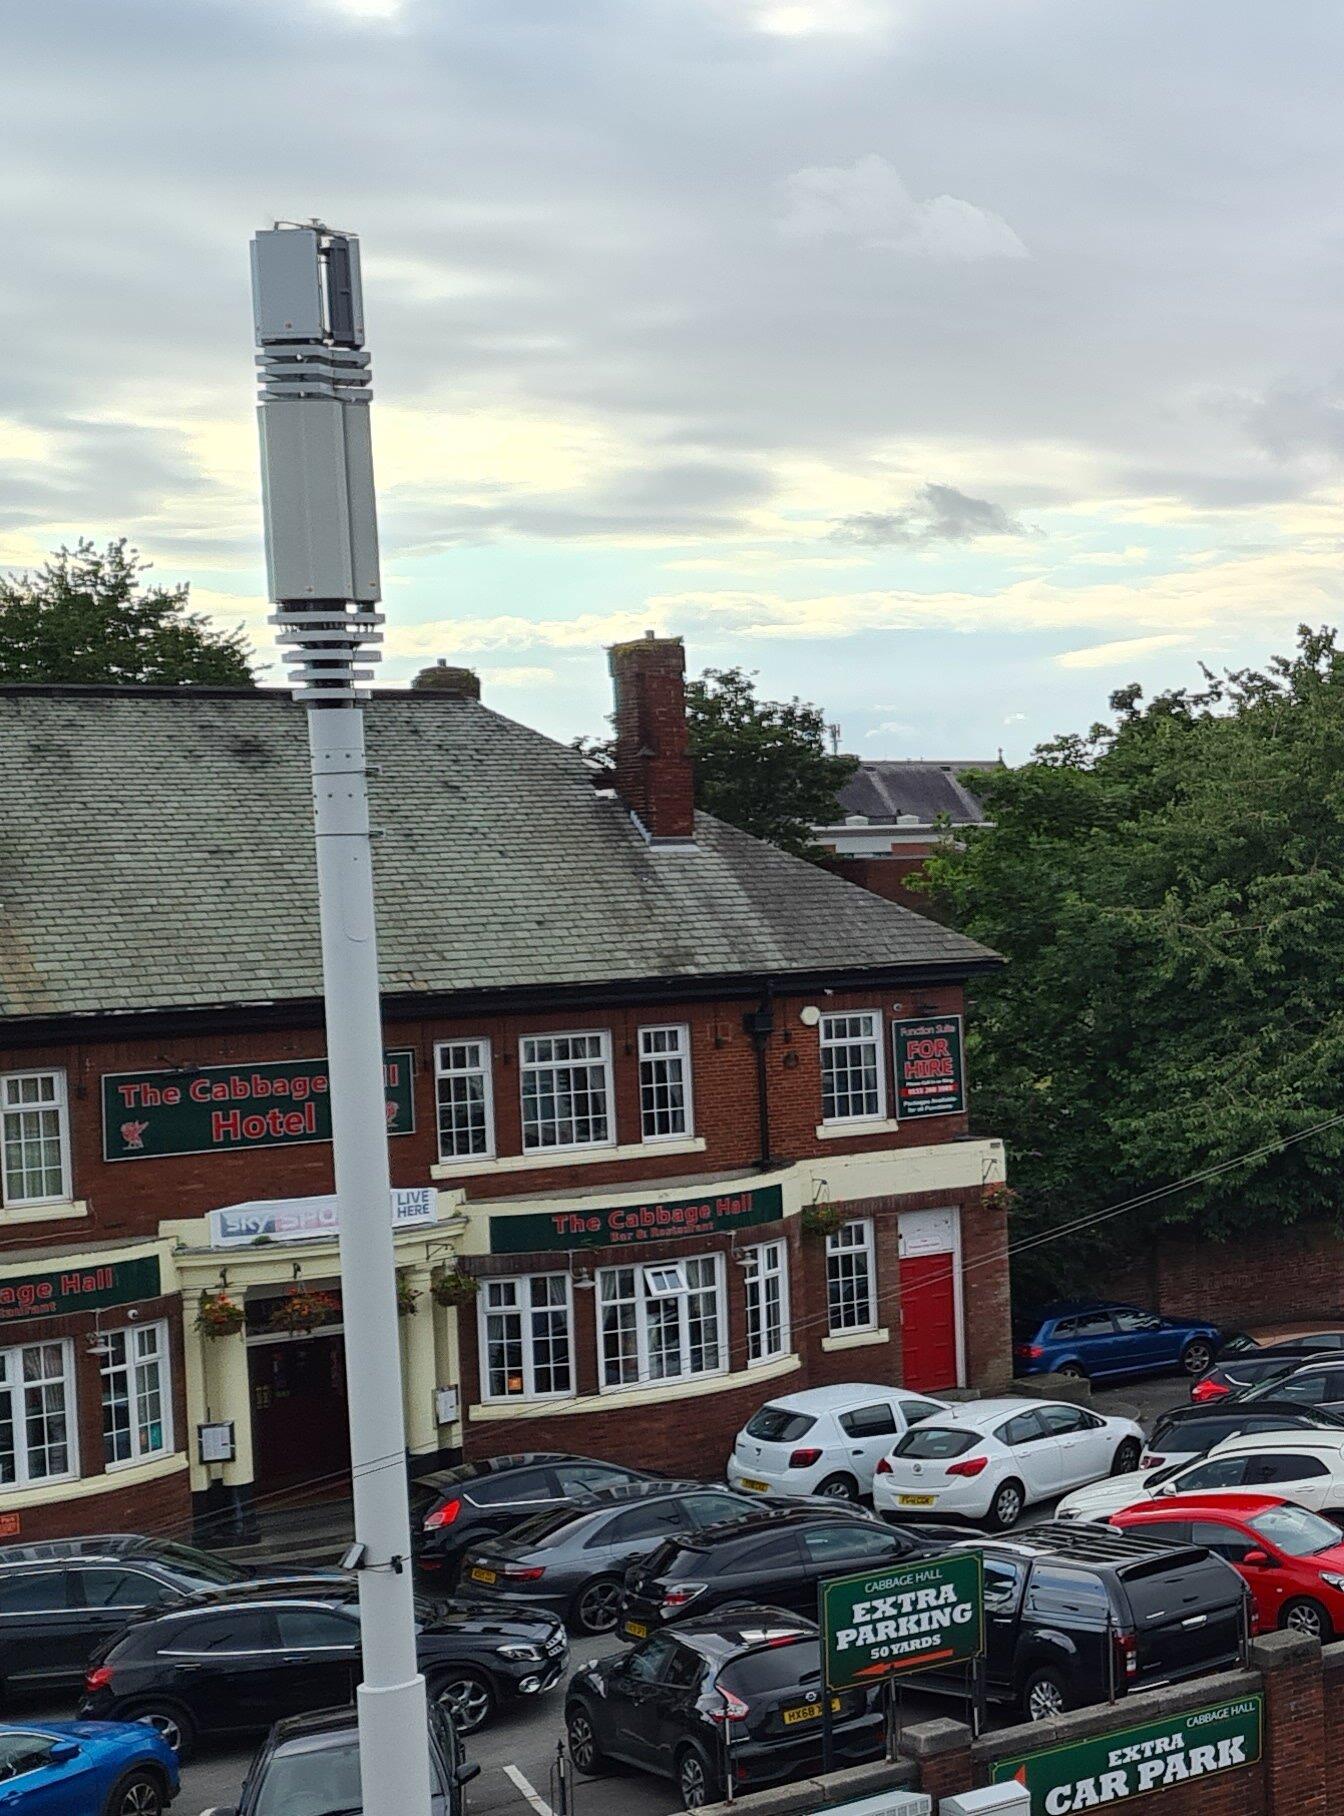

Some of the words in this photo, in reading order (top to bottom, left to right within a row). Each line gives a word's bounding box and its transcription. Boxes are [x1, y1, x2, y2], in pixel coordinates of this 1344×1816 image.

[907, 1038, 951, 1060] FOR
[904, 1057, 954, 1080] HIRE
[118, 1083, 181, 1108] The
[189, 1074, 328, 1102] Cabbage
[211, 1102, 316, 1142] Hotel
[397, 1190, 430, 1206] LIVE
[397, 1203, 430, 1219] HERE
[552, 1214, 600, 1235] The
[608, 1202, 711, 1231] Cabbage
[715, 1193, 754, 1216] Hall
[610, 1231, 633, 1243] Bar
[635, 1229, 648, 1240] &
[650, 1221, 715, 1239] Restaurant
[61, 1267, 114, 1296] Hall
[865, 1574, 914, 1593] CABBAGE
[915, 1568, 943, 1584] HALL
[852, 1583, 958, 1624] EXTRA
[836, 1602, 973, 1651] PARKING
[870, 1646, 890, 1660] 50
[891, 1634, 942, 1654] YARDS
[1186, 1708, 1229, 1729] CABBAGE
[1230, 1702, 1256, 1717] HALL
[1108, 1732, 1185, 1768] EXTRA
[1045, 1768, 1130, 1816] CAR
[1138, 1734, 1246, 1791] PARK
